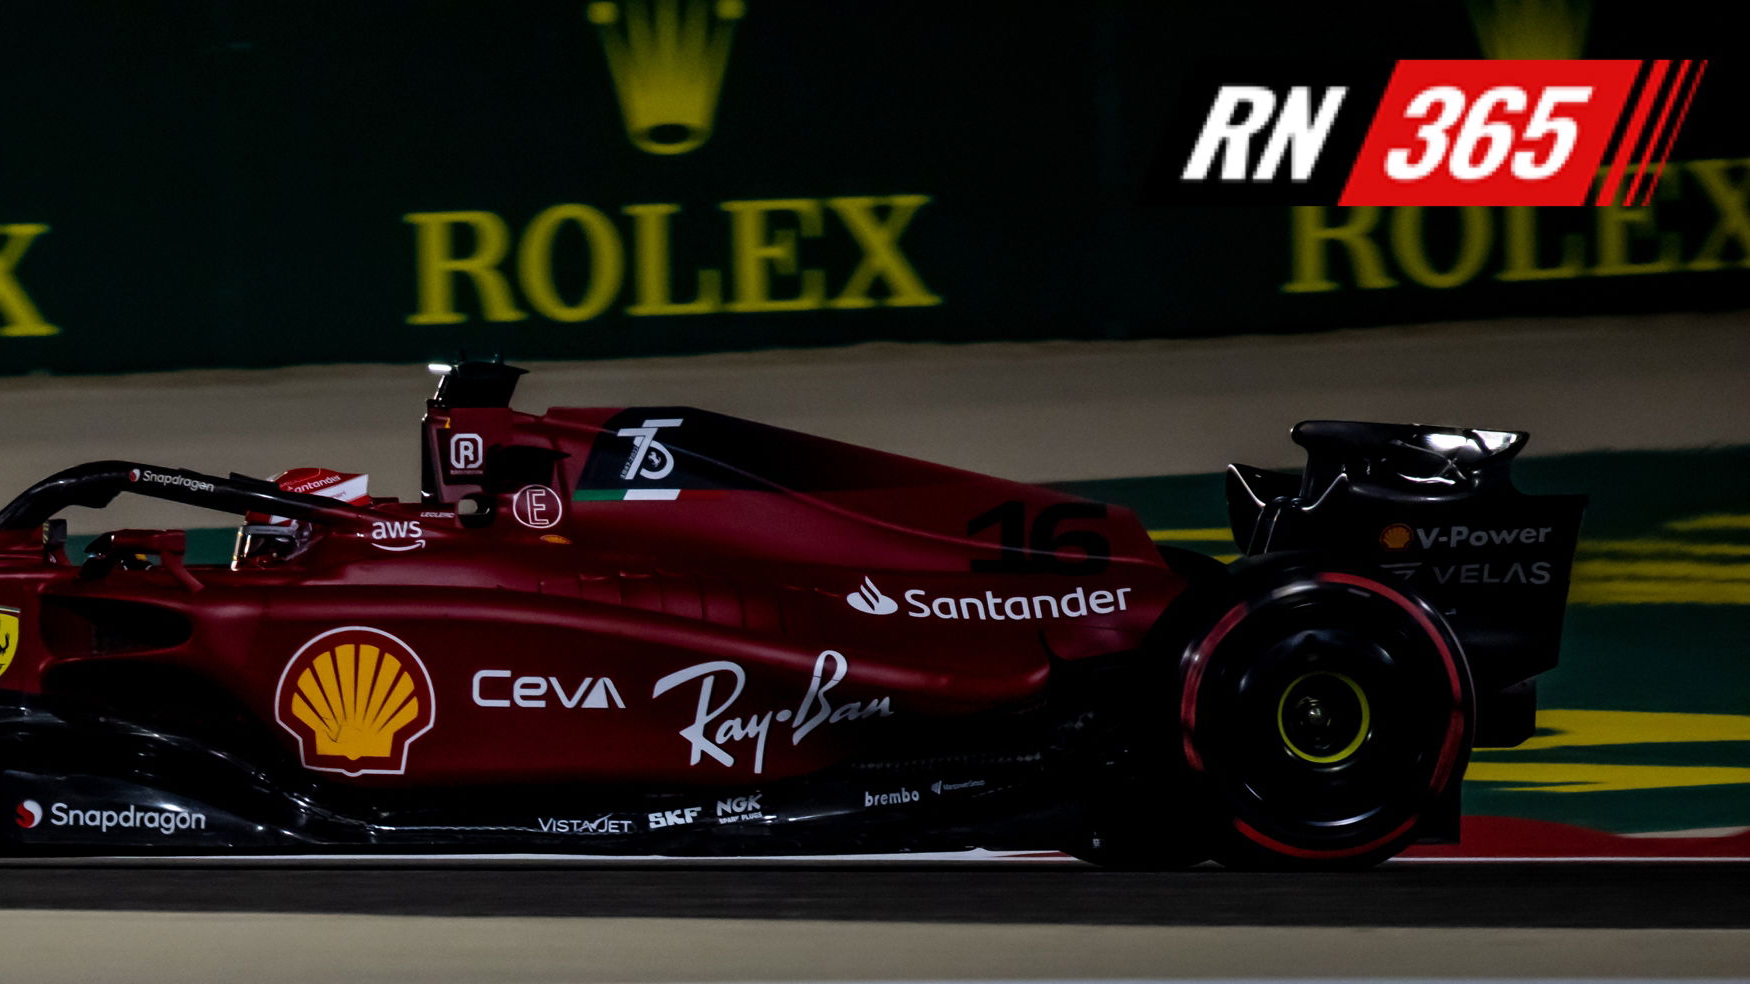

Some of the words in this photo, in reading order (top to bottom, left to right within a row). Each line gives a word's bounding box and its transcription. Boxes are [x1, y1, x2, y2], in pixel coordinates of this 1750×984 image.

[402, 194, 944, 324] ROLEX
[142, 471, 215, 493] Snapdragon
[289, 475, 342, 493] antander
[371, 521, 422, 540] aws
[967, 502, 1108, 575] 16
[1416, 525, 1553, 550] V-Power
[1432, 561, 1552, 585] VELAS
[906, 585, 1131, 621] Santander
[716, 793, 762, 816] NGK
[864, 787, 921, 807] brembo
[51, 803, 205, 835] Snapdragon
[648, 806, 702, 829] SKF
